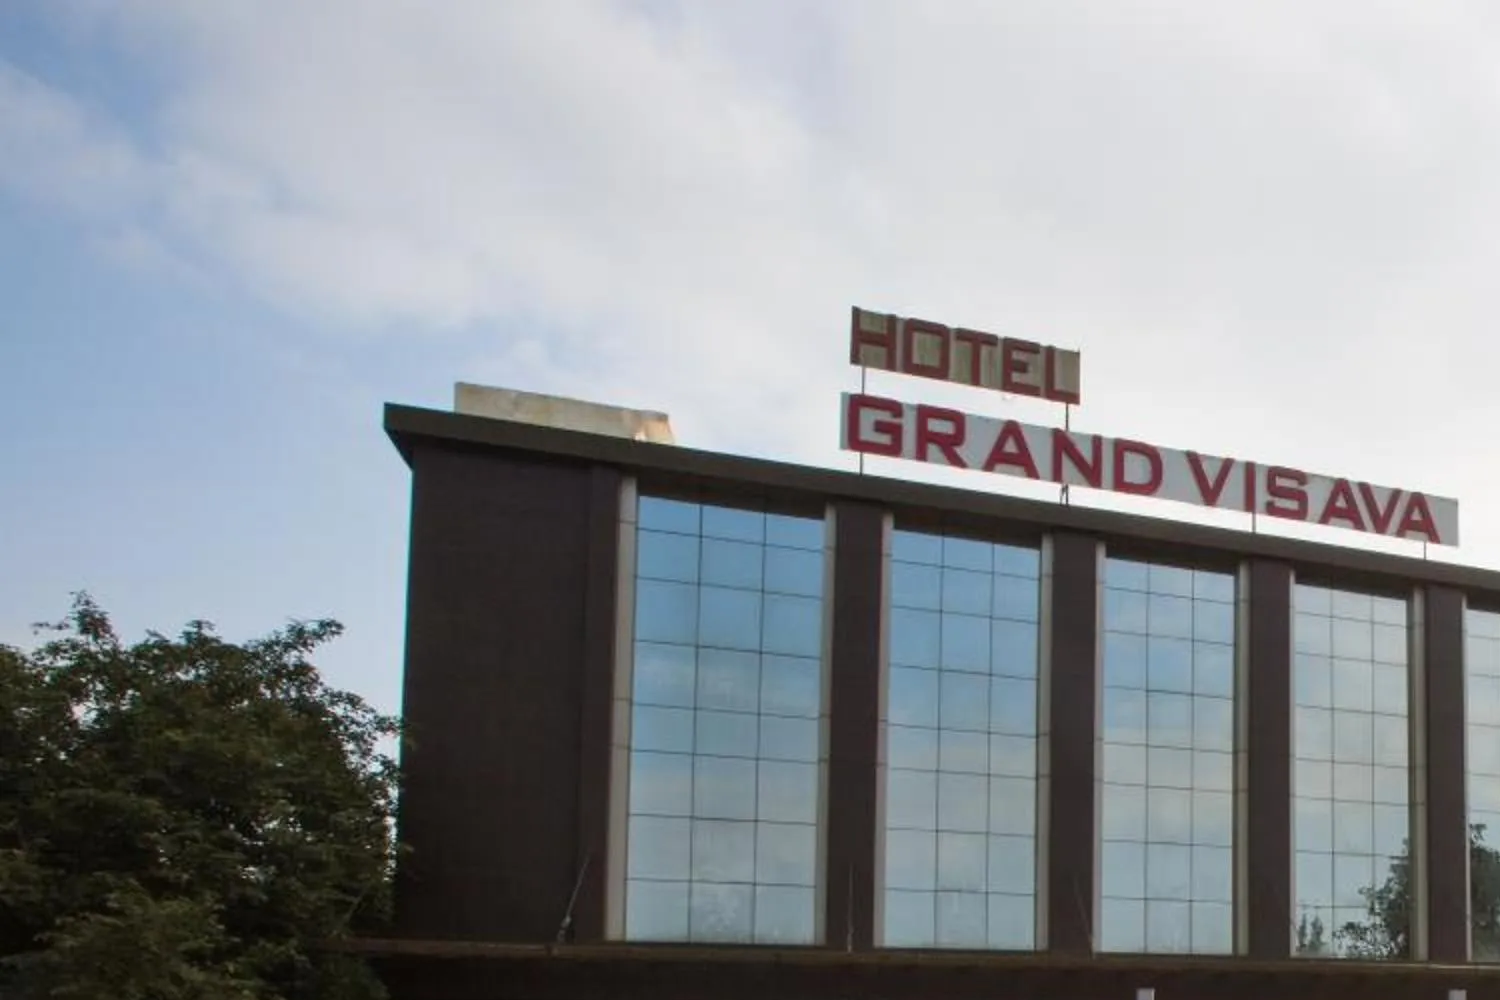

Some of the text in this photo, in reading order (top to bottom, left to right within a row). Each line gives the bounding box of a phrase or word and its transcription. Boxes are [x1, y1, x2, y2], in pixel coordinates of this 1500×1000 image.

[852, 306, 1080, 404] HOTEL
[848, 394, 1440, 544] GRAND VISAVA
